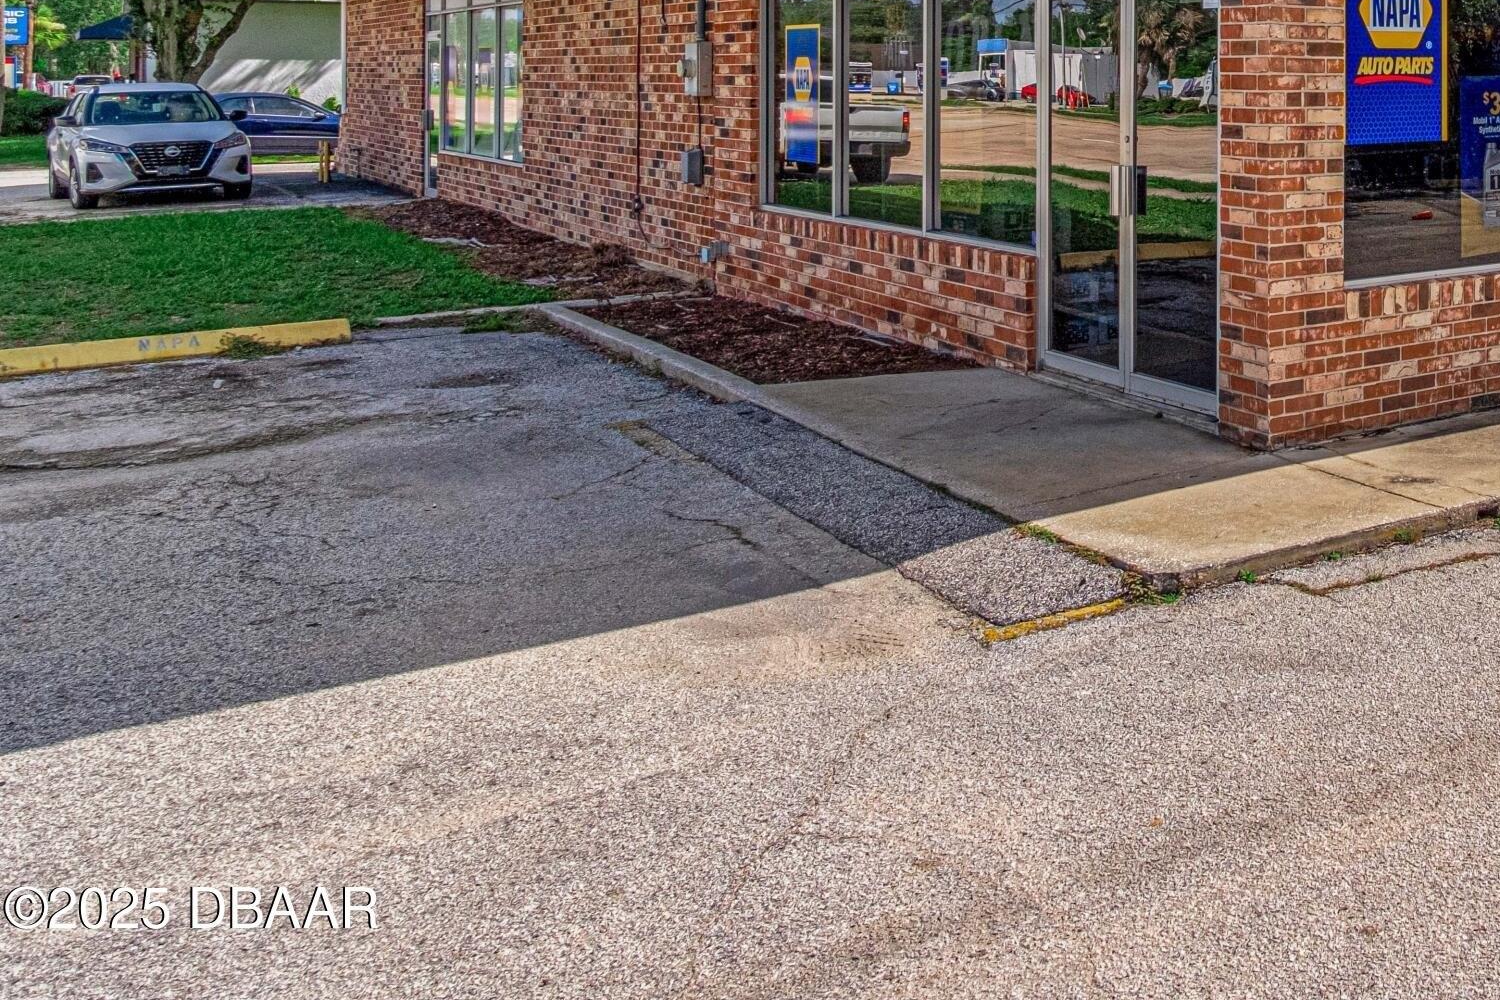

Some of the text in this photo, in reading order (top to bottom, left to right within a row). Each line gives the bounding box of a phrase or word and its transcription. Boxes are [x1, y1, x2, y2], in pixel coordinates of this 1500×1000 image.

[1357, 56, 1434, 76] AUTO PARTS
[138, 335, 200, 352] NAPA
